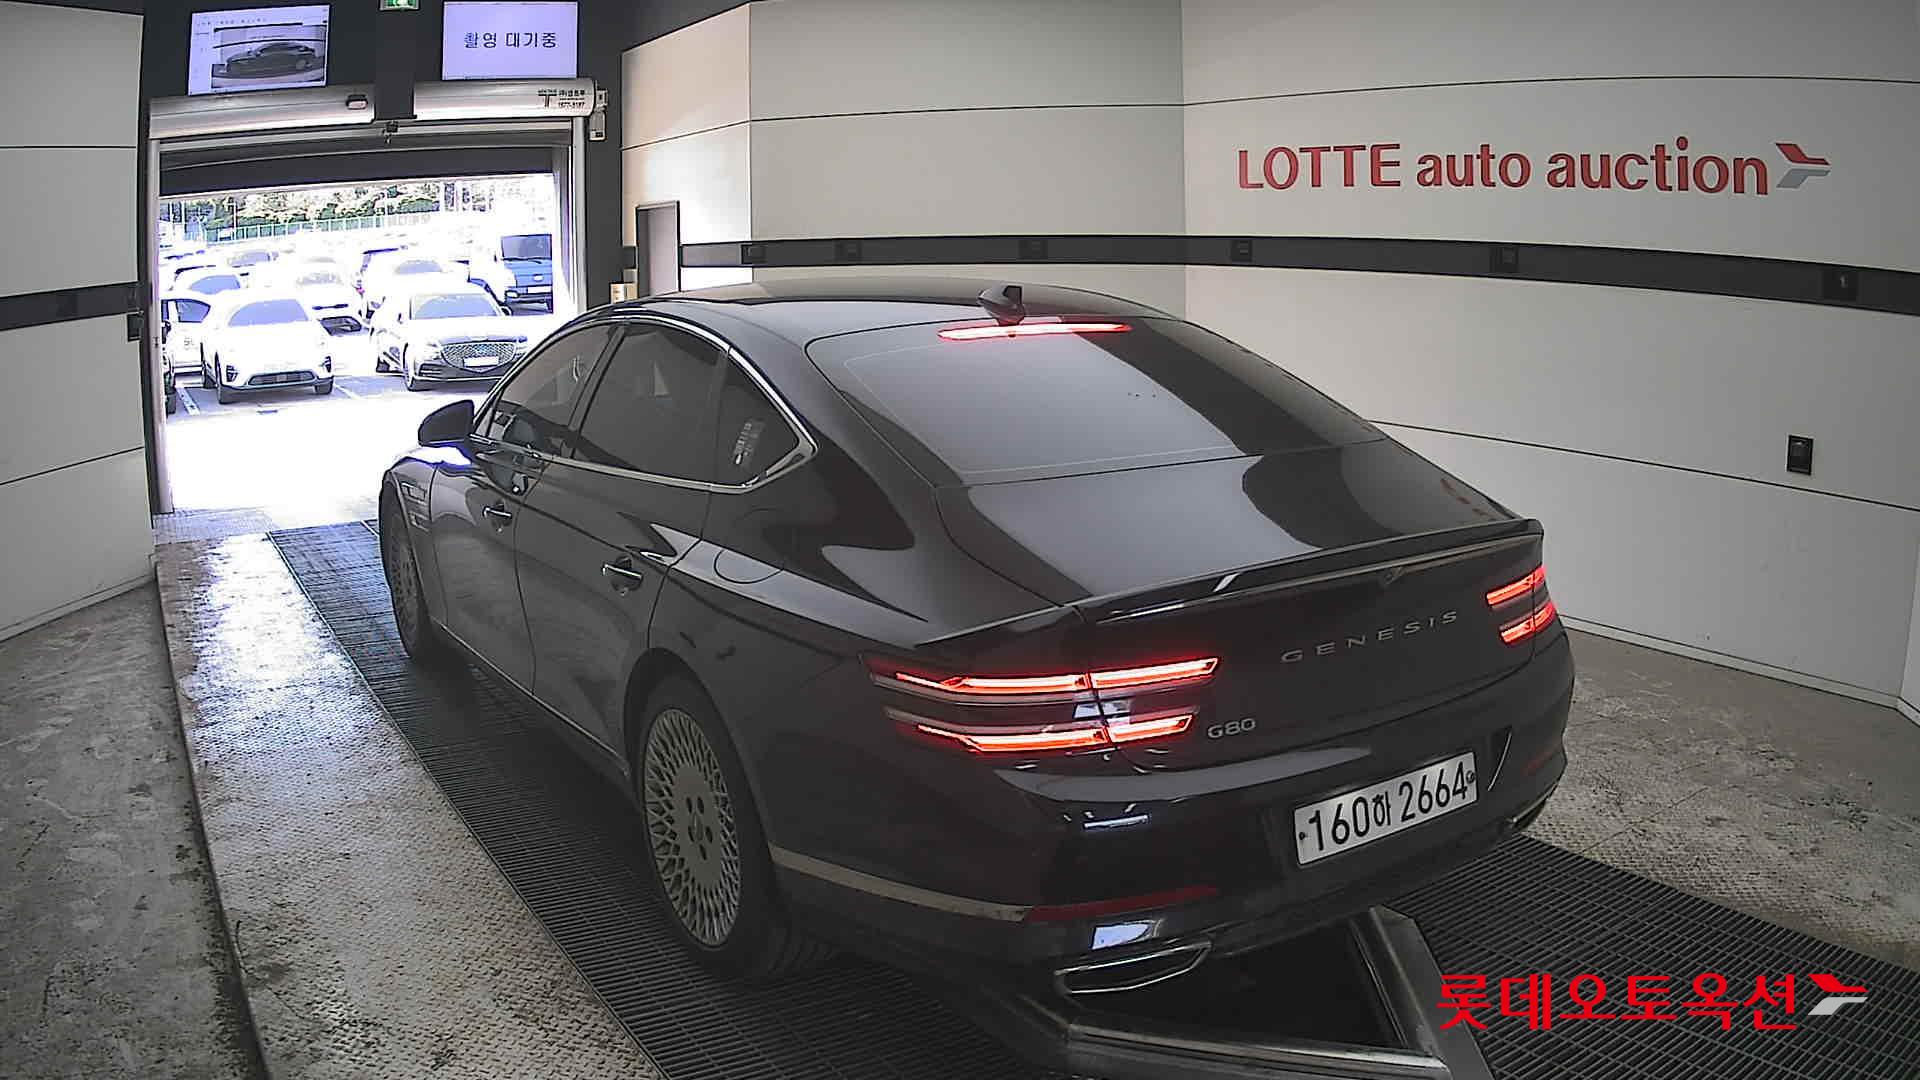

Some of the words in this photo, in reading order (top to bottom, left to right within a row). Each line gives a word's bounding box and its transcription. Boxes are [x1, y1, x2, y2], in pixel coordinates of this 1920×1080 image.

[464, 31, 497, 49] 촬영
[505, 31, 557, 49] 대기중
[1237, 143, 1400, 190] LOTTE
[1415, 143, 1532, 188] auto
[1546, 135, 1769, 196] auction
[1280, 609, 1457, 664] GENESIS
[1207, 717, 1257, 739] G80
[1308, 791, 1392, 851] 160하
[1398, 760, 1468, 823] 2664
